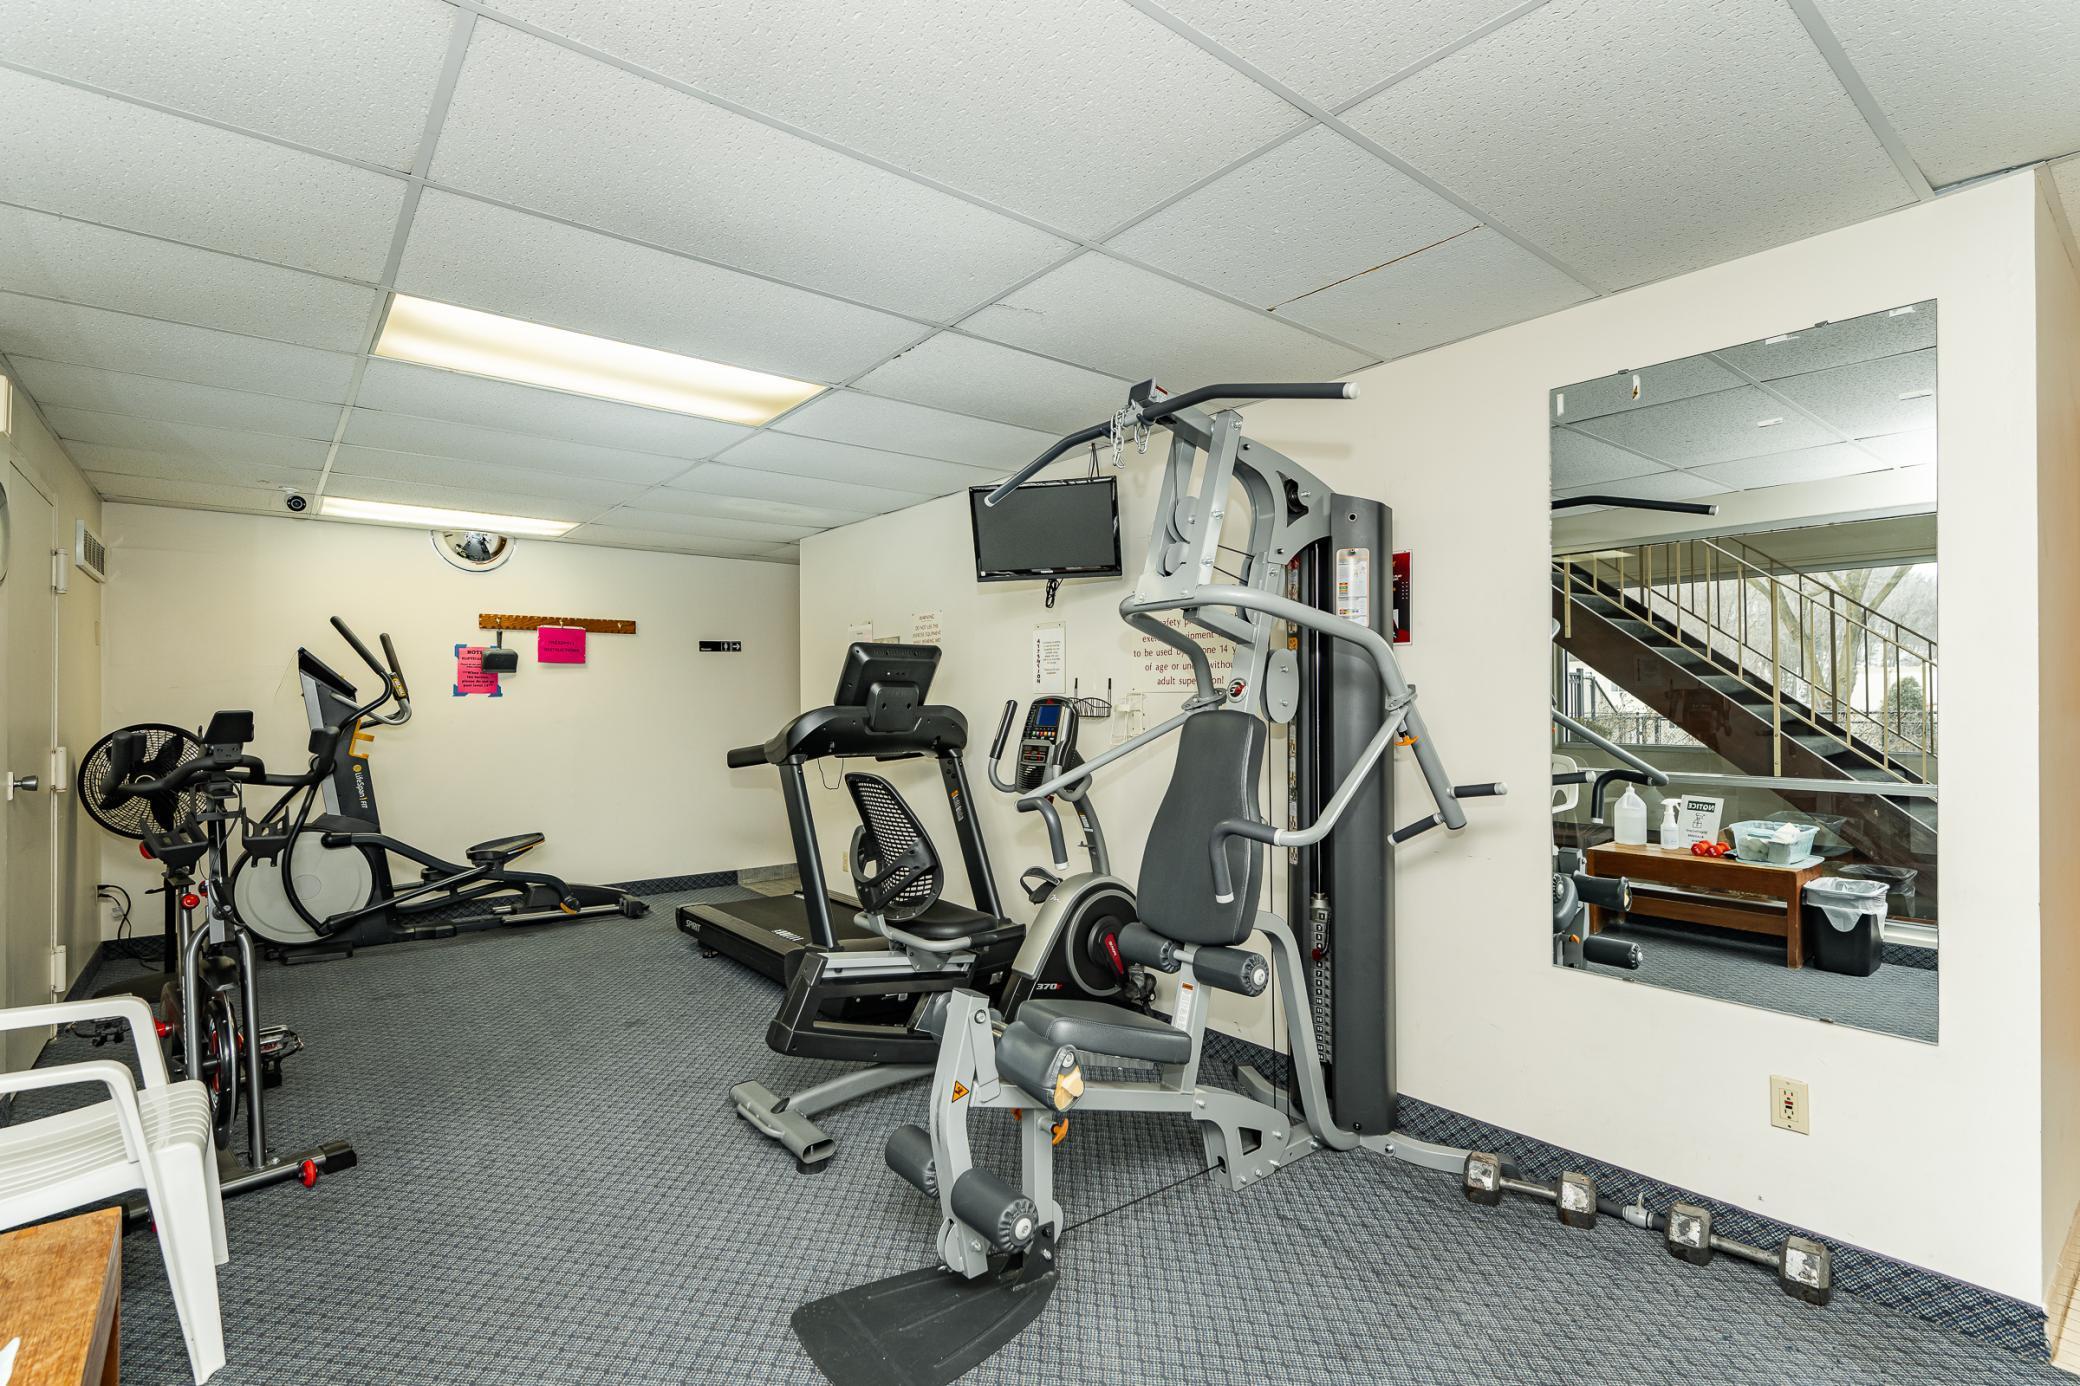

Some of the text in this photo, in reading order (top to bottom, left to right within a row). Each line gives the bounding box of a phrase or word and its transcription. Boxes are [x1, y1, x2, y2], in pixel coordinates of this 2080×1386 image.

[1133, 649, 1141, 657] to
[1144, 648, 1153, 657] be
[1156, 646, 1173, 656] used
[1220, 644, 1228, 652] 14
[1144, 662, 1152, 671] of
[1155, 663, 1169, 673] age
[1171, 662, 1179, 670] or
[1157, 675, 1175, 685] adult
[685, 919, 702, 932] SPIRIT
